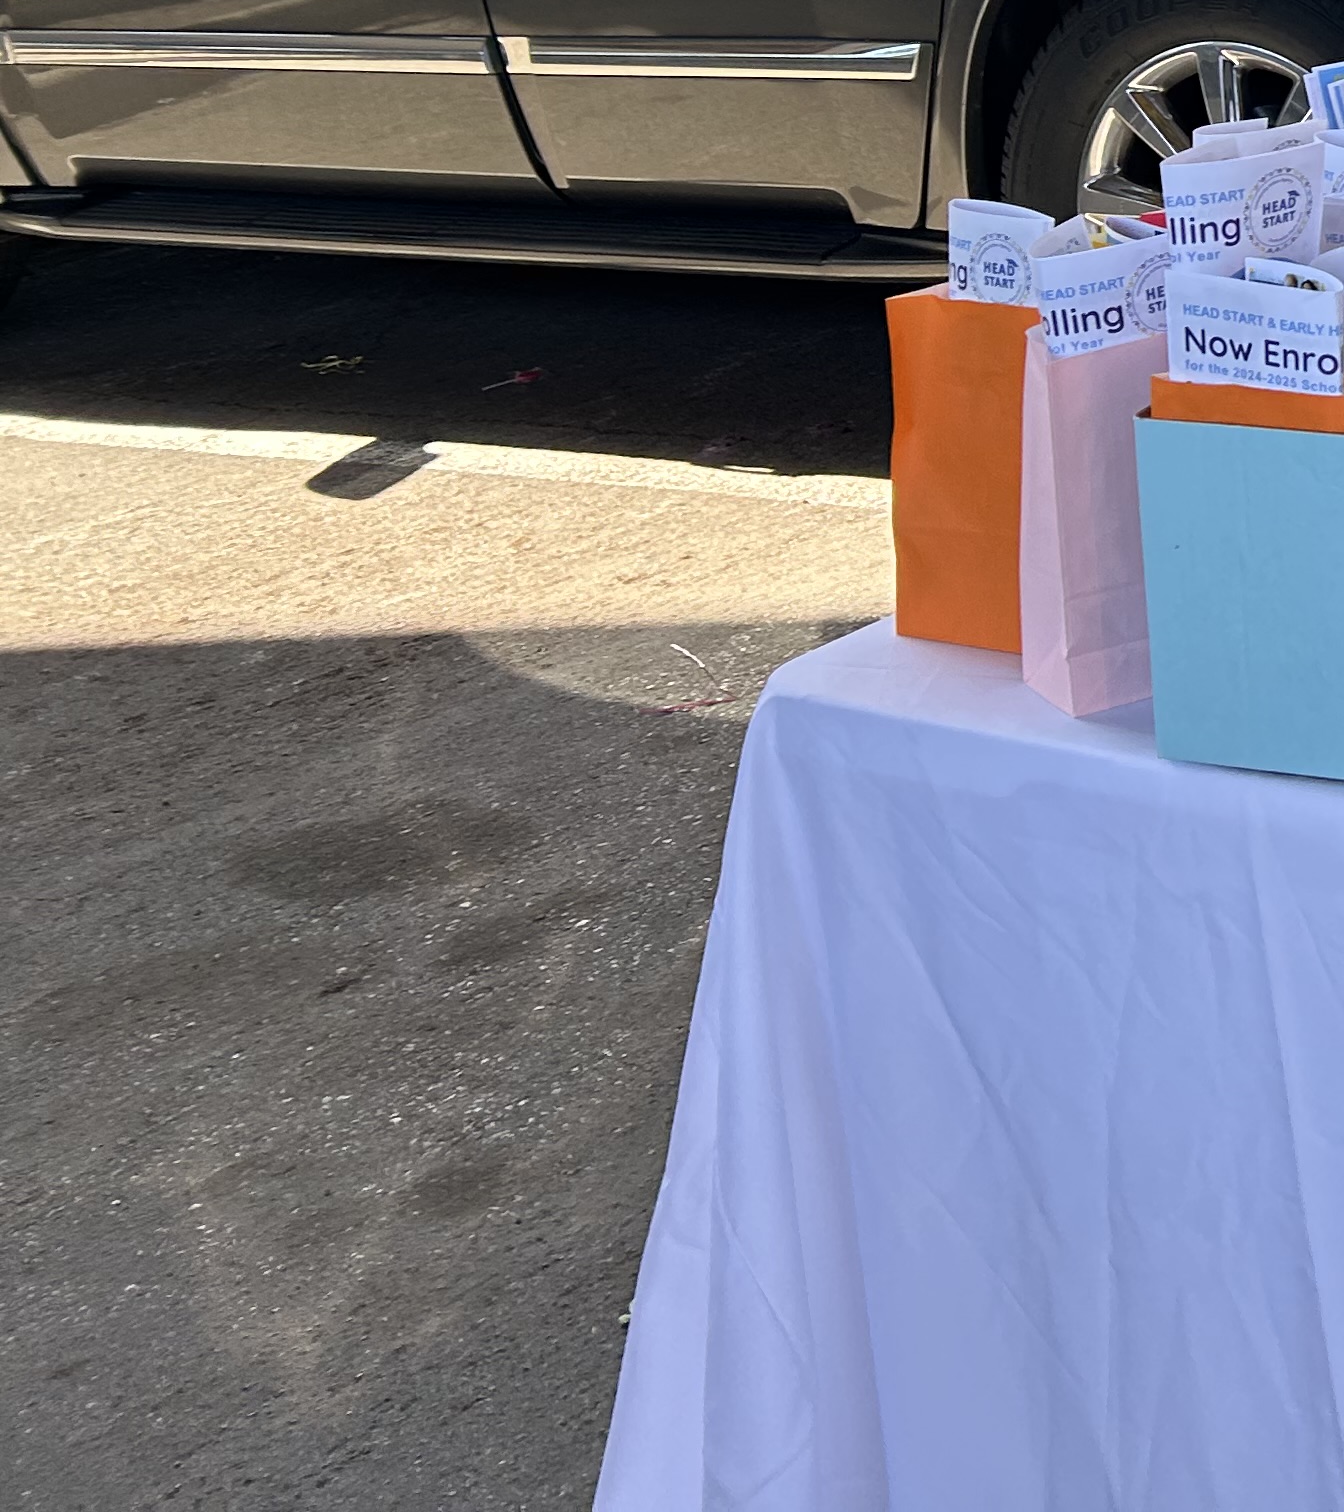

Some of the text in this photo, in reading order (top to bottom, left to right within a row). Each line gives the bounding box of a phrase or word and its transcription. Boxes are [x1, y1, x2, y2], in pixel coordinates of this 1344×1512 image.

[1165, 188, 1246, 208] EAD START
[1262, 196, 1297, 216] HEAD
[1262, 210, 1297, 229] START
[1187, 250, 1221, 263] Year
[983, 261, 1016, 277] HEAD
[983, 275, 1016, 289] START
[1080, 276, 1126, 296] START
[1183, 303, 1220, 320] HEAD
[1222, 309, 1264, 329] START
[1268, 317, 1277, 329] &
[1279, 319, 1325, 336] EARLY
[1069, 338, 1104, 353] Year
[1184, 325, 1340, 376] Now Enro
[1184, 359, 1203, 372] for
[1208, 363, 1229, 376] the
[1232, 366, 1298, 389] 2024-2025
